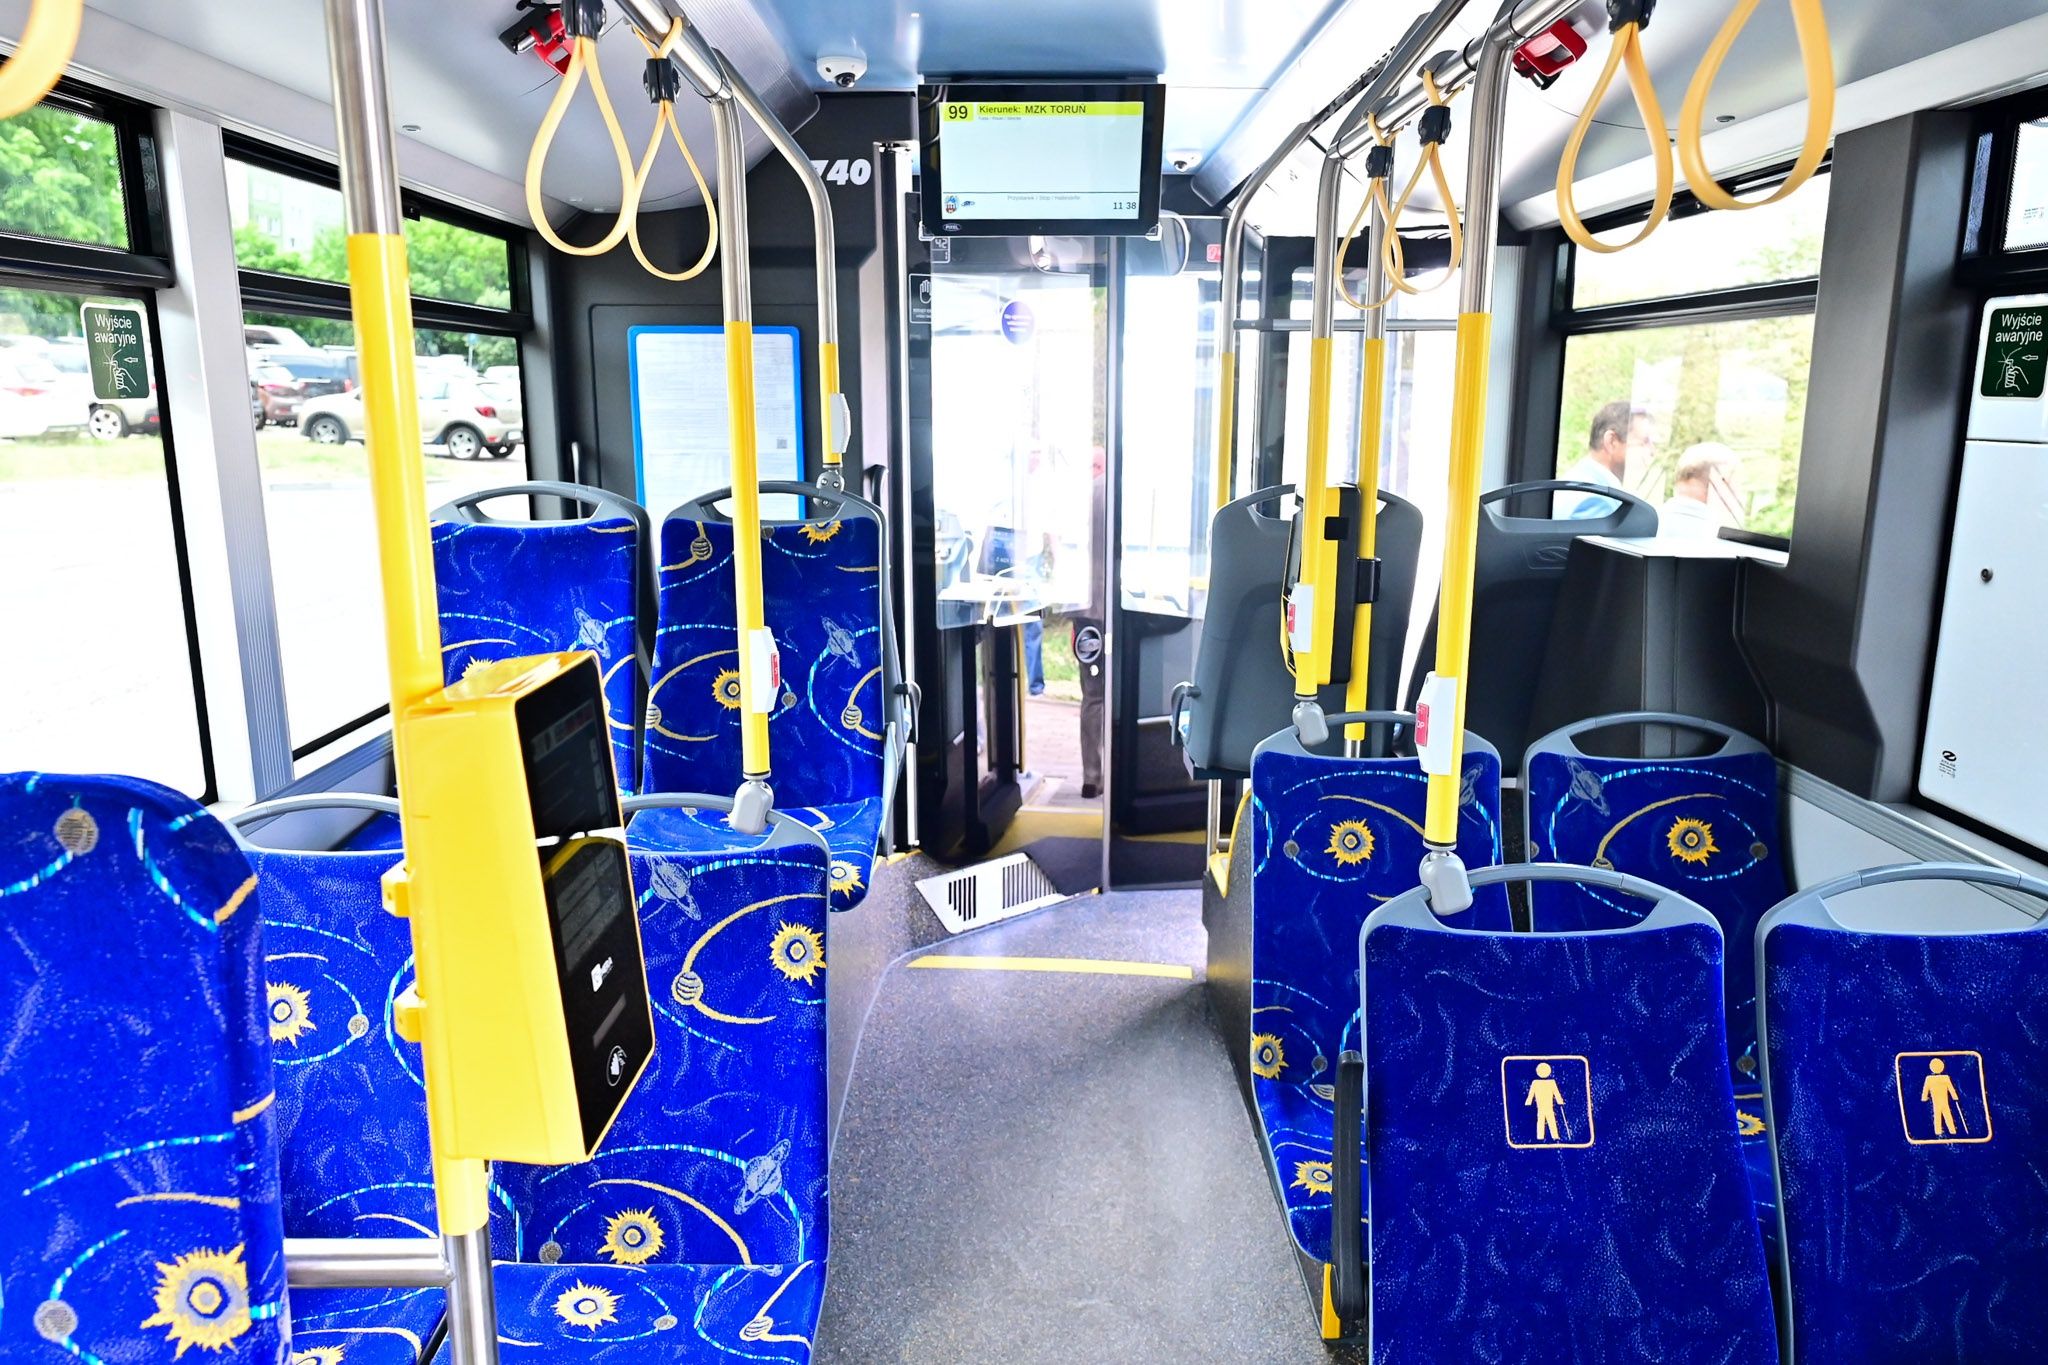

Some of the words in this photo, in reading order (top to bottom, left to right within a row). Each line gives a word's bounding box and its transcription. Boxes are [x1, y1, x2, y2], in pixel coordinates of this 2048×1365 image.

[949, 105, 968, 119] 99
[979, 105, 1021, 114] Kierunek:
[1025, 105, 1047, 114] MZK
[94, 313, 132, 331] Wyjście
[2001, 312, 2042, 330] Wyjście
[94, 331, 137, 347] awaryjne
[1995, 328, 2043, 345] awaryjne
